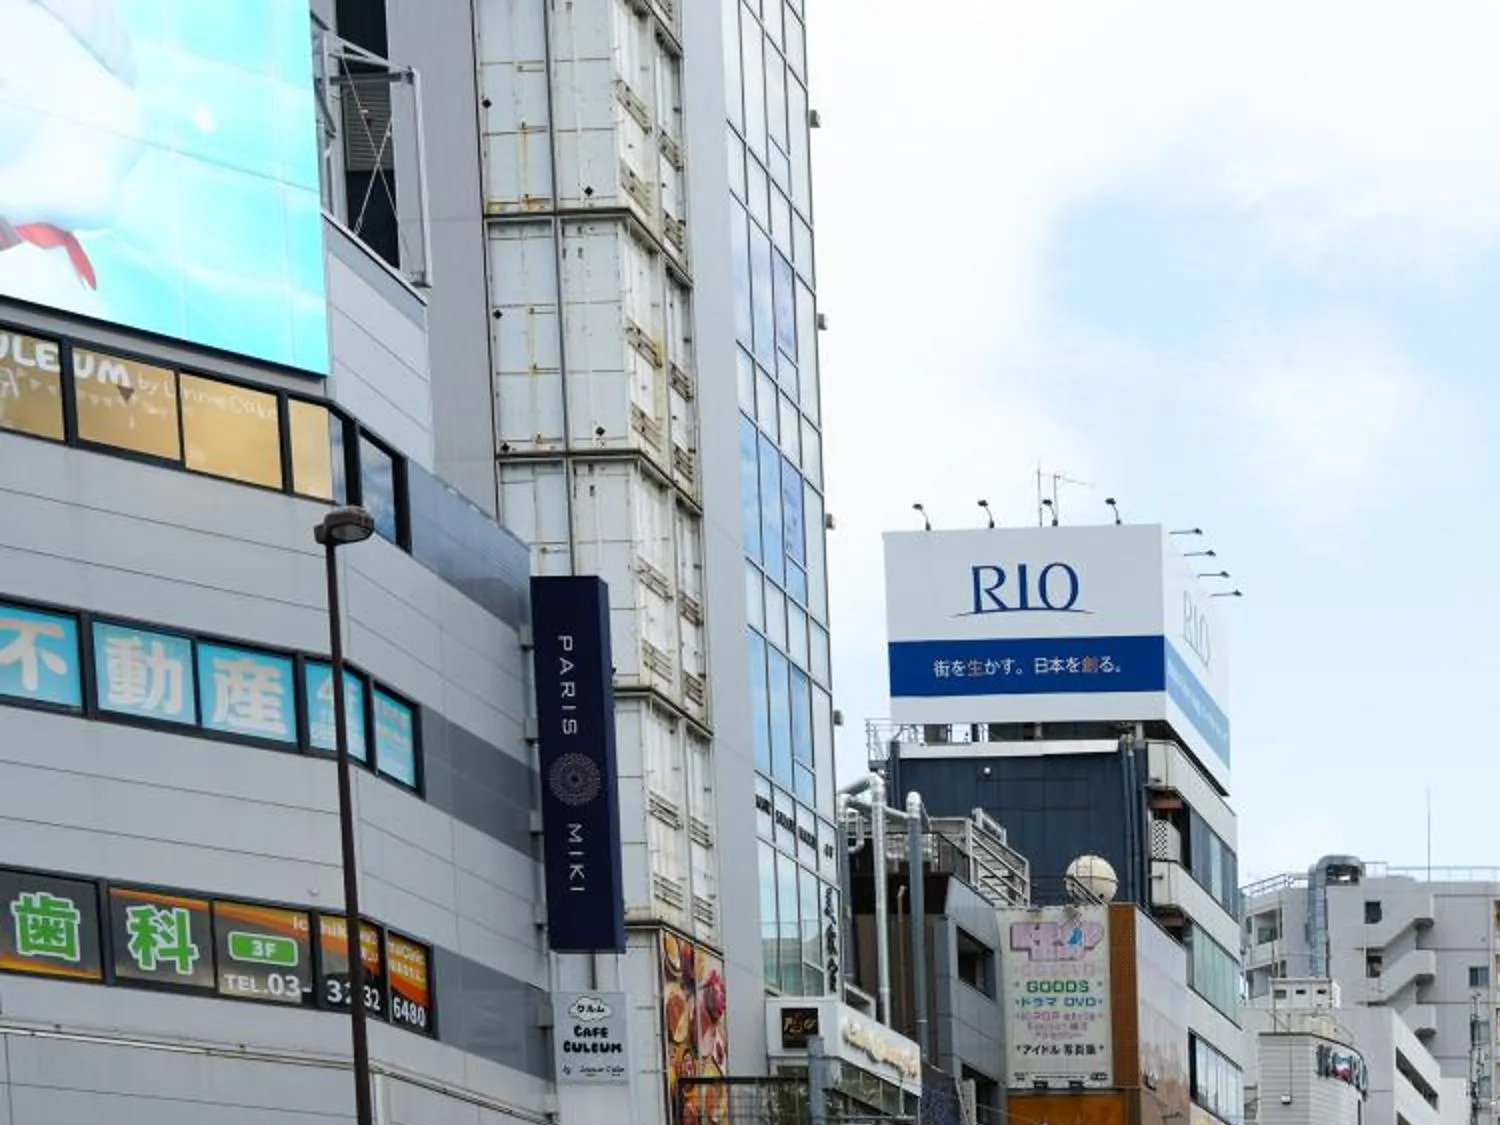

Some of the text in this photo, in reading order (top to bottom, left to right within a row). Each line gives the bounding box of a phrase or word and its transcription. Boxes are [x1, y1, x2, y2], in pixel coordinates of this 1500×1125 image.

[971, 561, 1079, 614] RIO
[0, 616, 289, 737] 不動産
[557, 635, 578, 735] PARIS
[568, 823, 586, 892] MIKI
[13, 891, 199, 976] 歯科
[251, 939, 277, 959] 3F
[392, 996, 426, 1028] 6480
[1026, 980, 1089, 993] GOODS
[573, 1025, 608, 1038] CAFE
